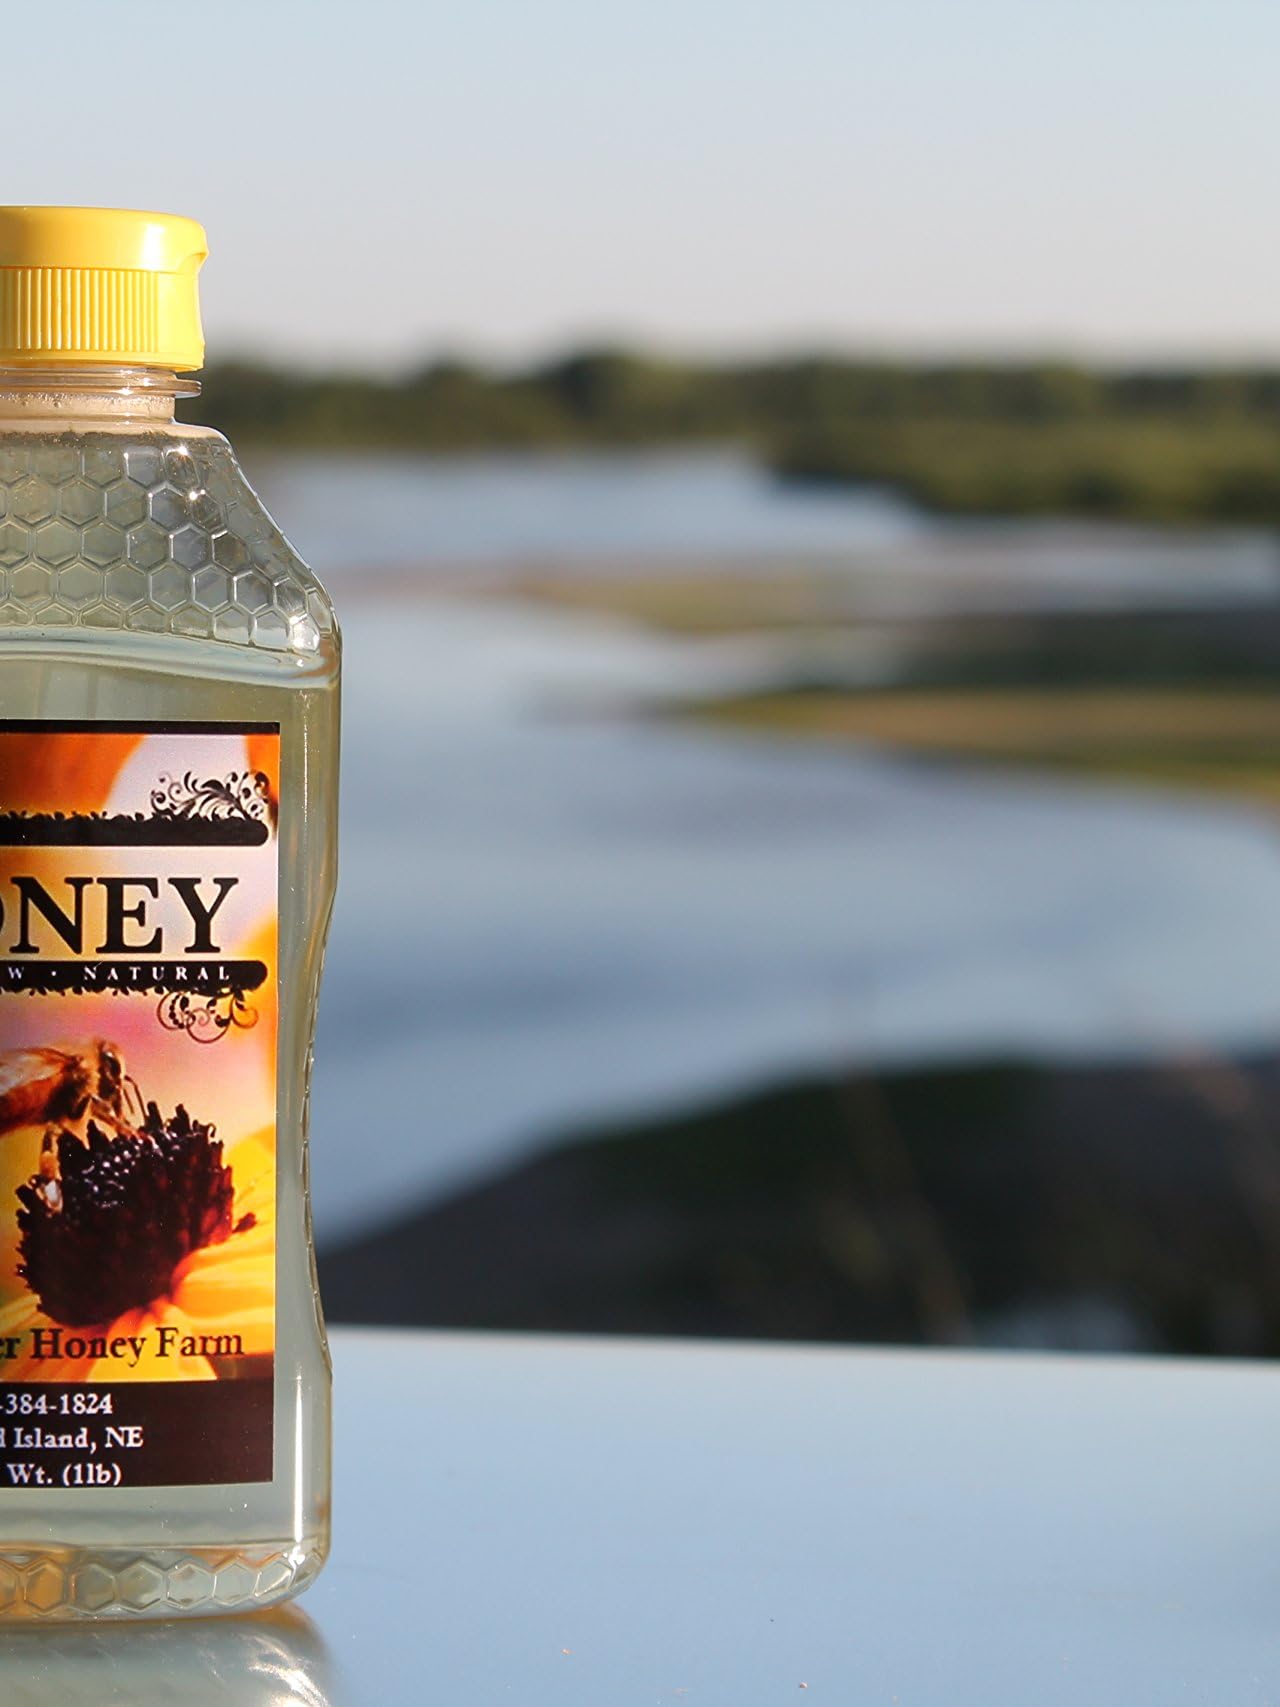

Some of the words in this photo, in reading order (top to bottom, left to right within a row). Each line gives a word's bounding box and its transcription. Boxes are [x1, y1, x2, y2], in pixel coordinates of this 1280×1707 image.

[82, 966, 230, 981] NATURAL
[30, 1328, 148, 1367] Honey
[155, 1327, 245, 1356] Farm
[13, 1427, 97, 1453] Island,
[105, 1427, 144, 1448] NE
[7, 1463, 53, 1485] Wt.
[62, 1463, 122, 1486] (1lb)
